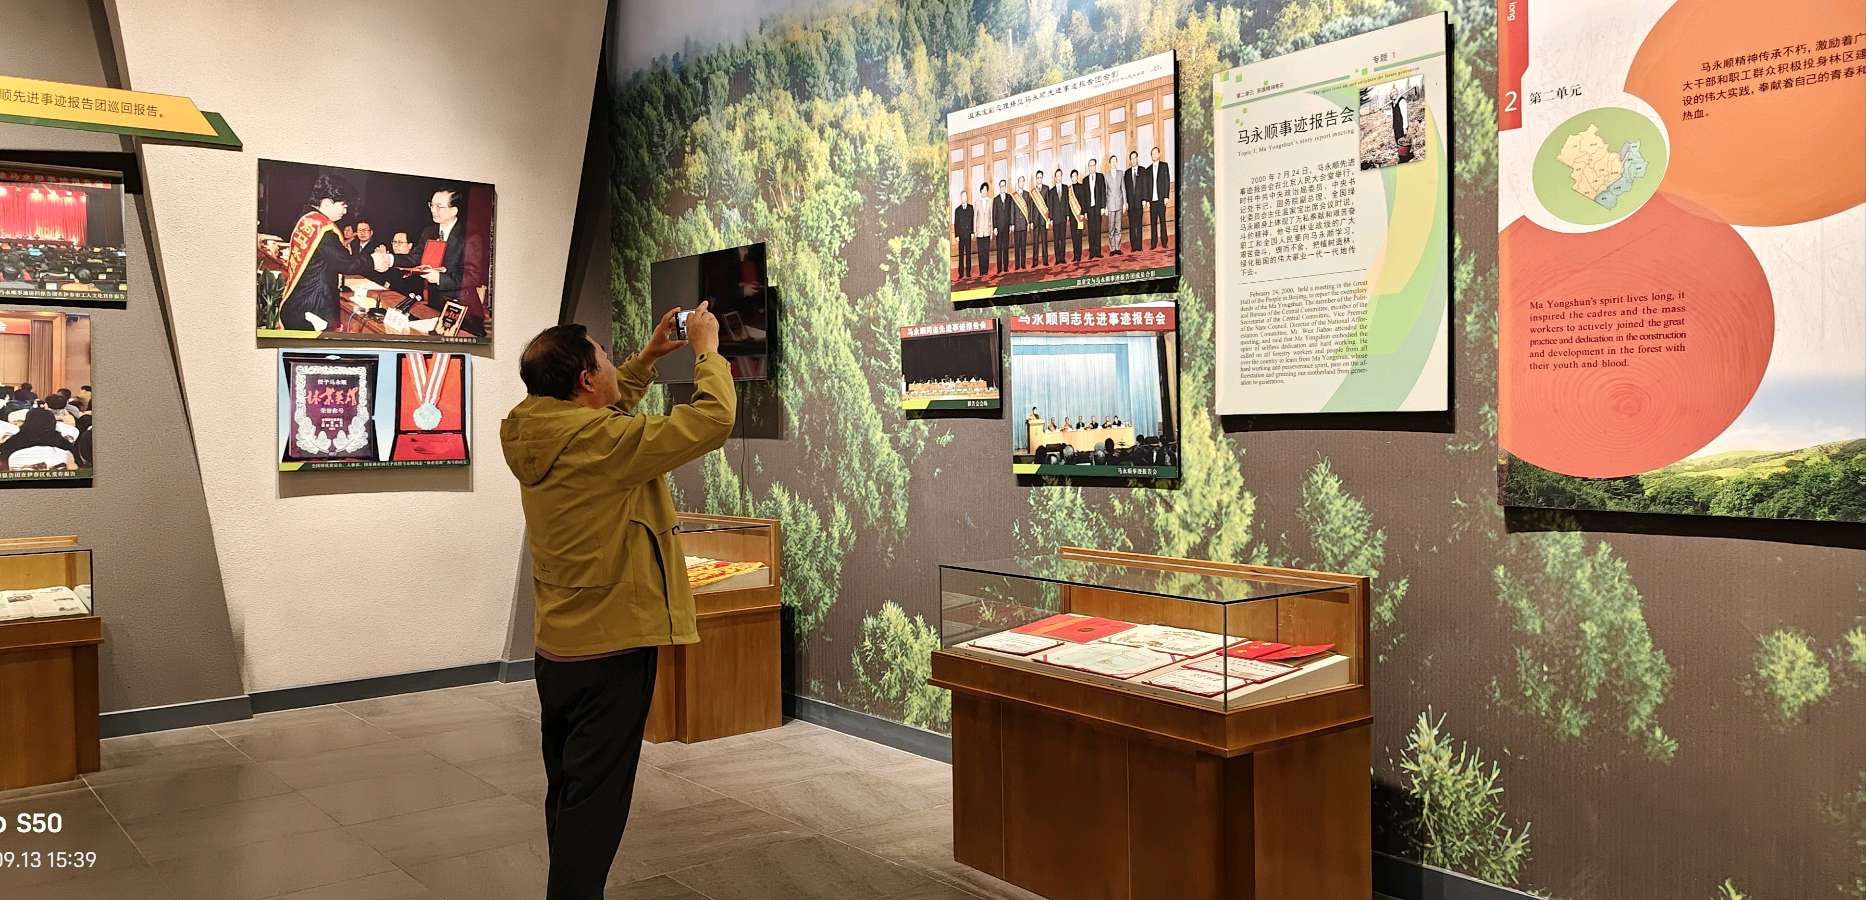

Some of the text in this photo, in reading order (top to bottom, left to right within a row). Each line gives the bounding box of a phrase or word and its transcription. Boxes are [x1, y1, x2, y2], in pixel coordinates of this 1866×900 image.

[1504, 91, 1517, 112] 2
[1530, 84, 1582, 104] 第二单元
[1682, 109, 1709, 121] 热血。
[1238, 106, 1354, 144] 马永顺事迹报告会
[1530, 290, 1684, 309] Ma Yongshun's spirit lives long, it
[1018, 311, 1166, 326] 马永顺同志先进事迹报告会
[1530, 311, 1565, 322] inspired
[1569, 311, 1584, 319] the
[1587, 309, 1616, 318] cadres
[1620, 307, 1638, 316] and
[1642, 306, 1658, 314] the
[1530, 325, 1564, 333] workers
[1578, 322, 1613, 331] actively
[1616, 319, 1644, 330] joined
[1648, 318, 1661, 327] the
[1663, 318, 1685, 328] great
[1530, 338, 1557, 348] practice
[1559, 336, 1573, 344] and
[1575, 335, 1613, 344] dedication
[1626, 333, 1638, 341] the
[1529, 350, 1544, 358] and
[1620, 346, 1635, 354] the
[1638, 345, 1662, 353] forest
[1666, 343, 1686, 352] with
[1553, 361, 1579, 371] youth
[1602, 359, 1629, 367] blood.
